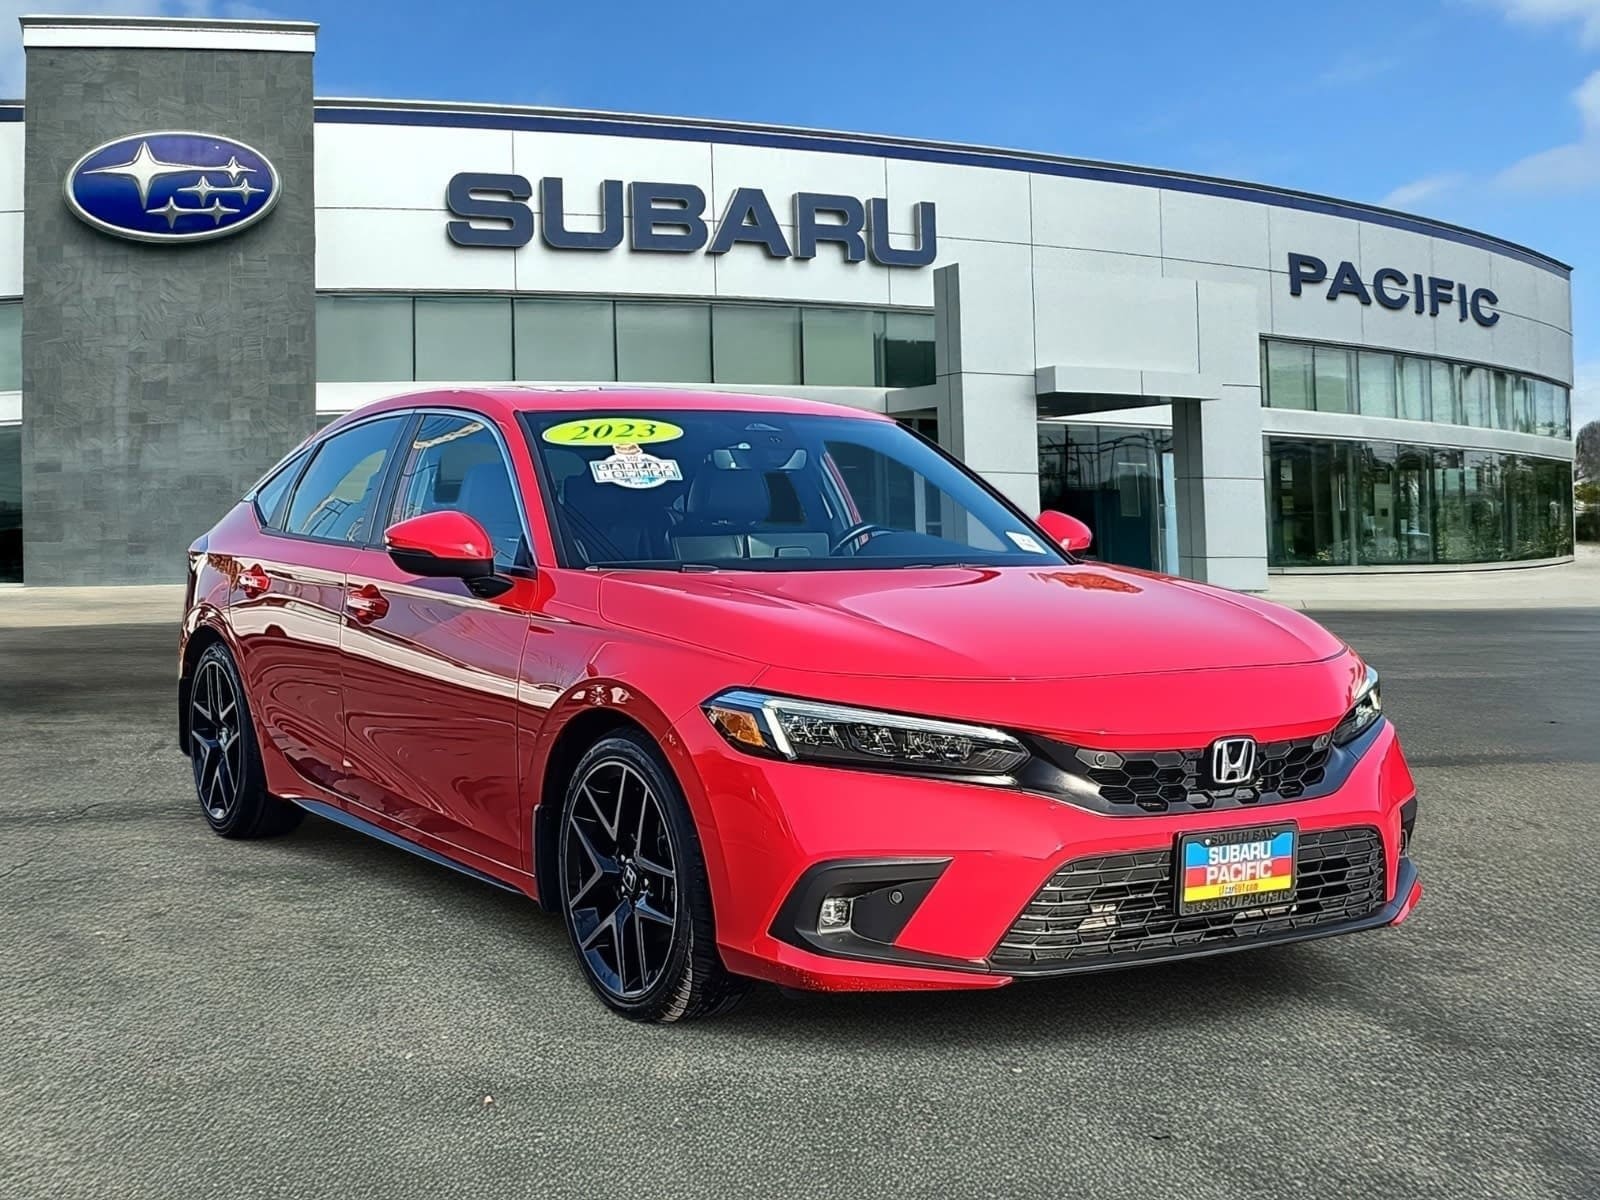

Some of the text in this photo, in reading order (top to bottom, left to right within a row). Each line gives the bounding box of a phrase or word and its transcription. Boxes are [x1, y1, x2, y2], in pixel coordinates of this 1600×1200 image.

[447, 171, 937, 267] SUBARU
[1288, 251, 1500, 328] PACIFIC
[571, 423, 657, 441] 2023
[1210, 831, 1250, 845] SOUTH
[1208, 840, 1272, 865] SUBARU
[1206, 859, 1273, 886] PACIFIC
[1184, 895, 1238, 913] SUBARU
[1241, 889, 1292, 905] PACIFIC
